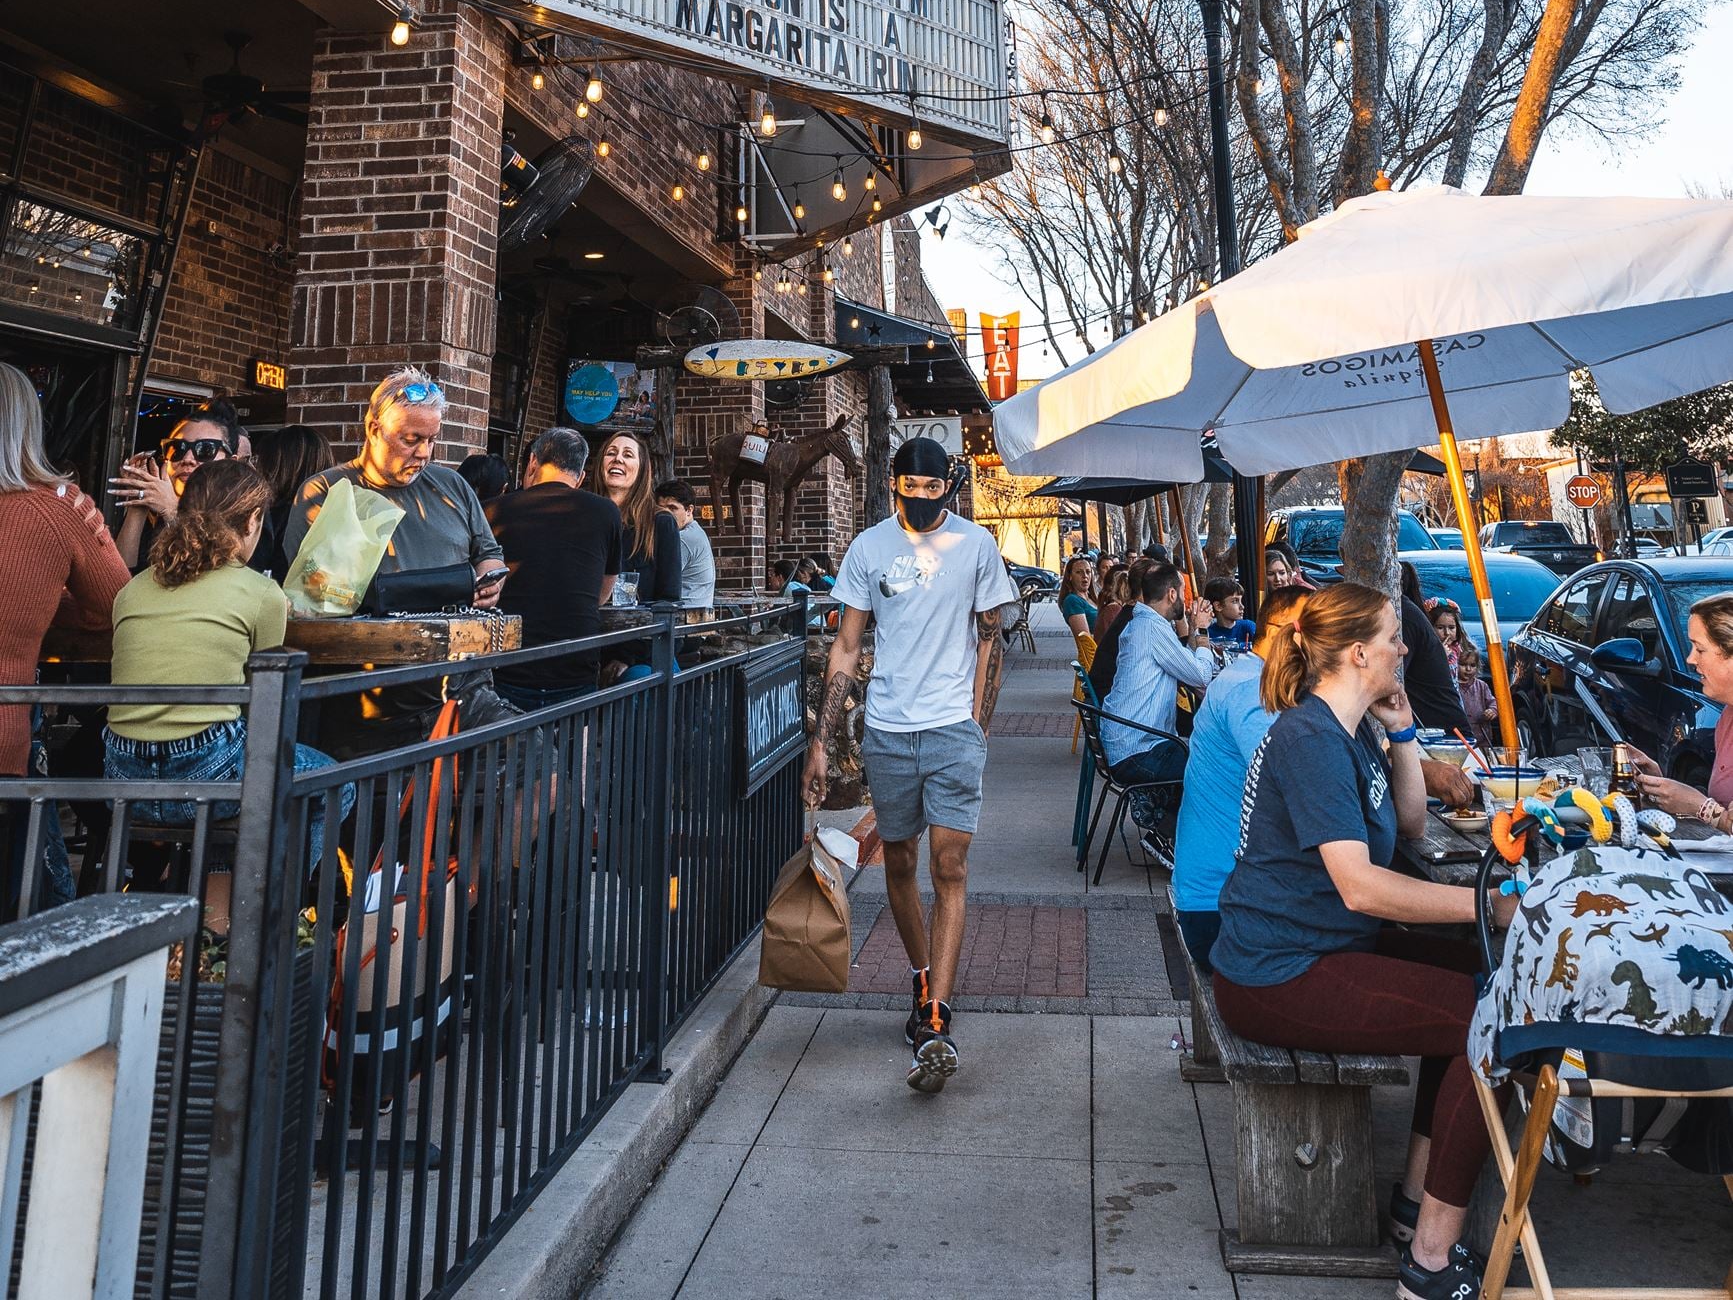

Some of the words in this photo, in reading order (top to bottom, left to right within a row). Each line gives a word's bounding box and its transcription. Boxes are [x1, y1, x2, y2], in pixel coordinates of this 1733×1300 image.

[884, 12, 901, 52] A
[872, 51, 918, 94] RUN
[992, 317, 1012, 398] EAT
[256, 361, 285, 390] OPEN
[1569, 486, 1597, 499] STOP
[1691, 501, 1700, 513] P
